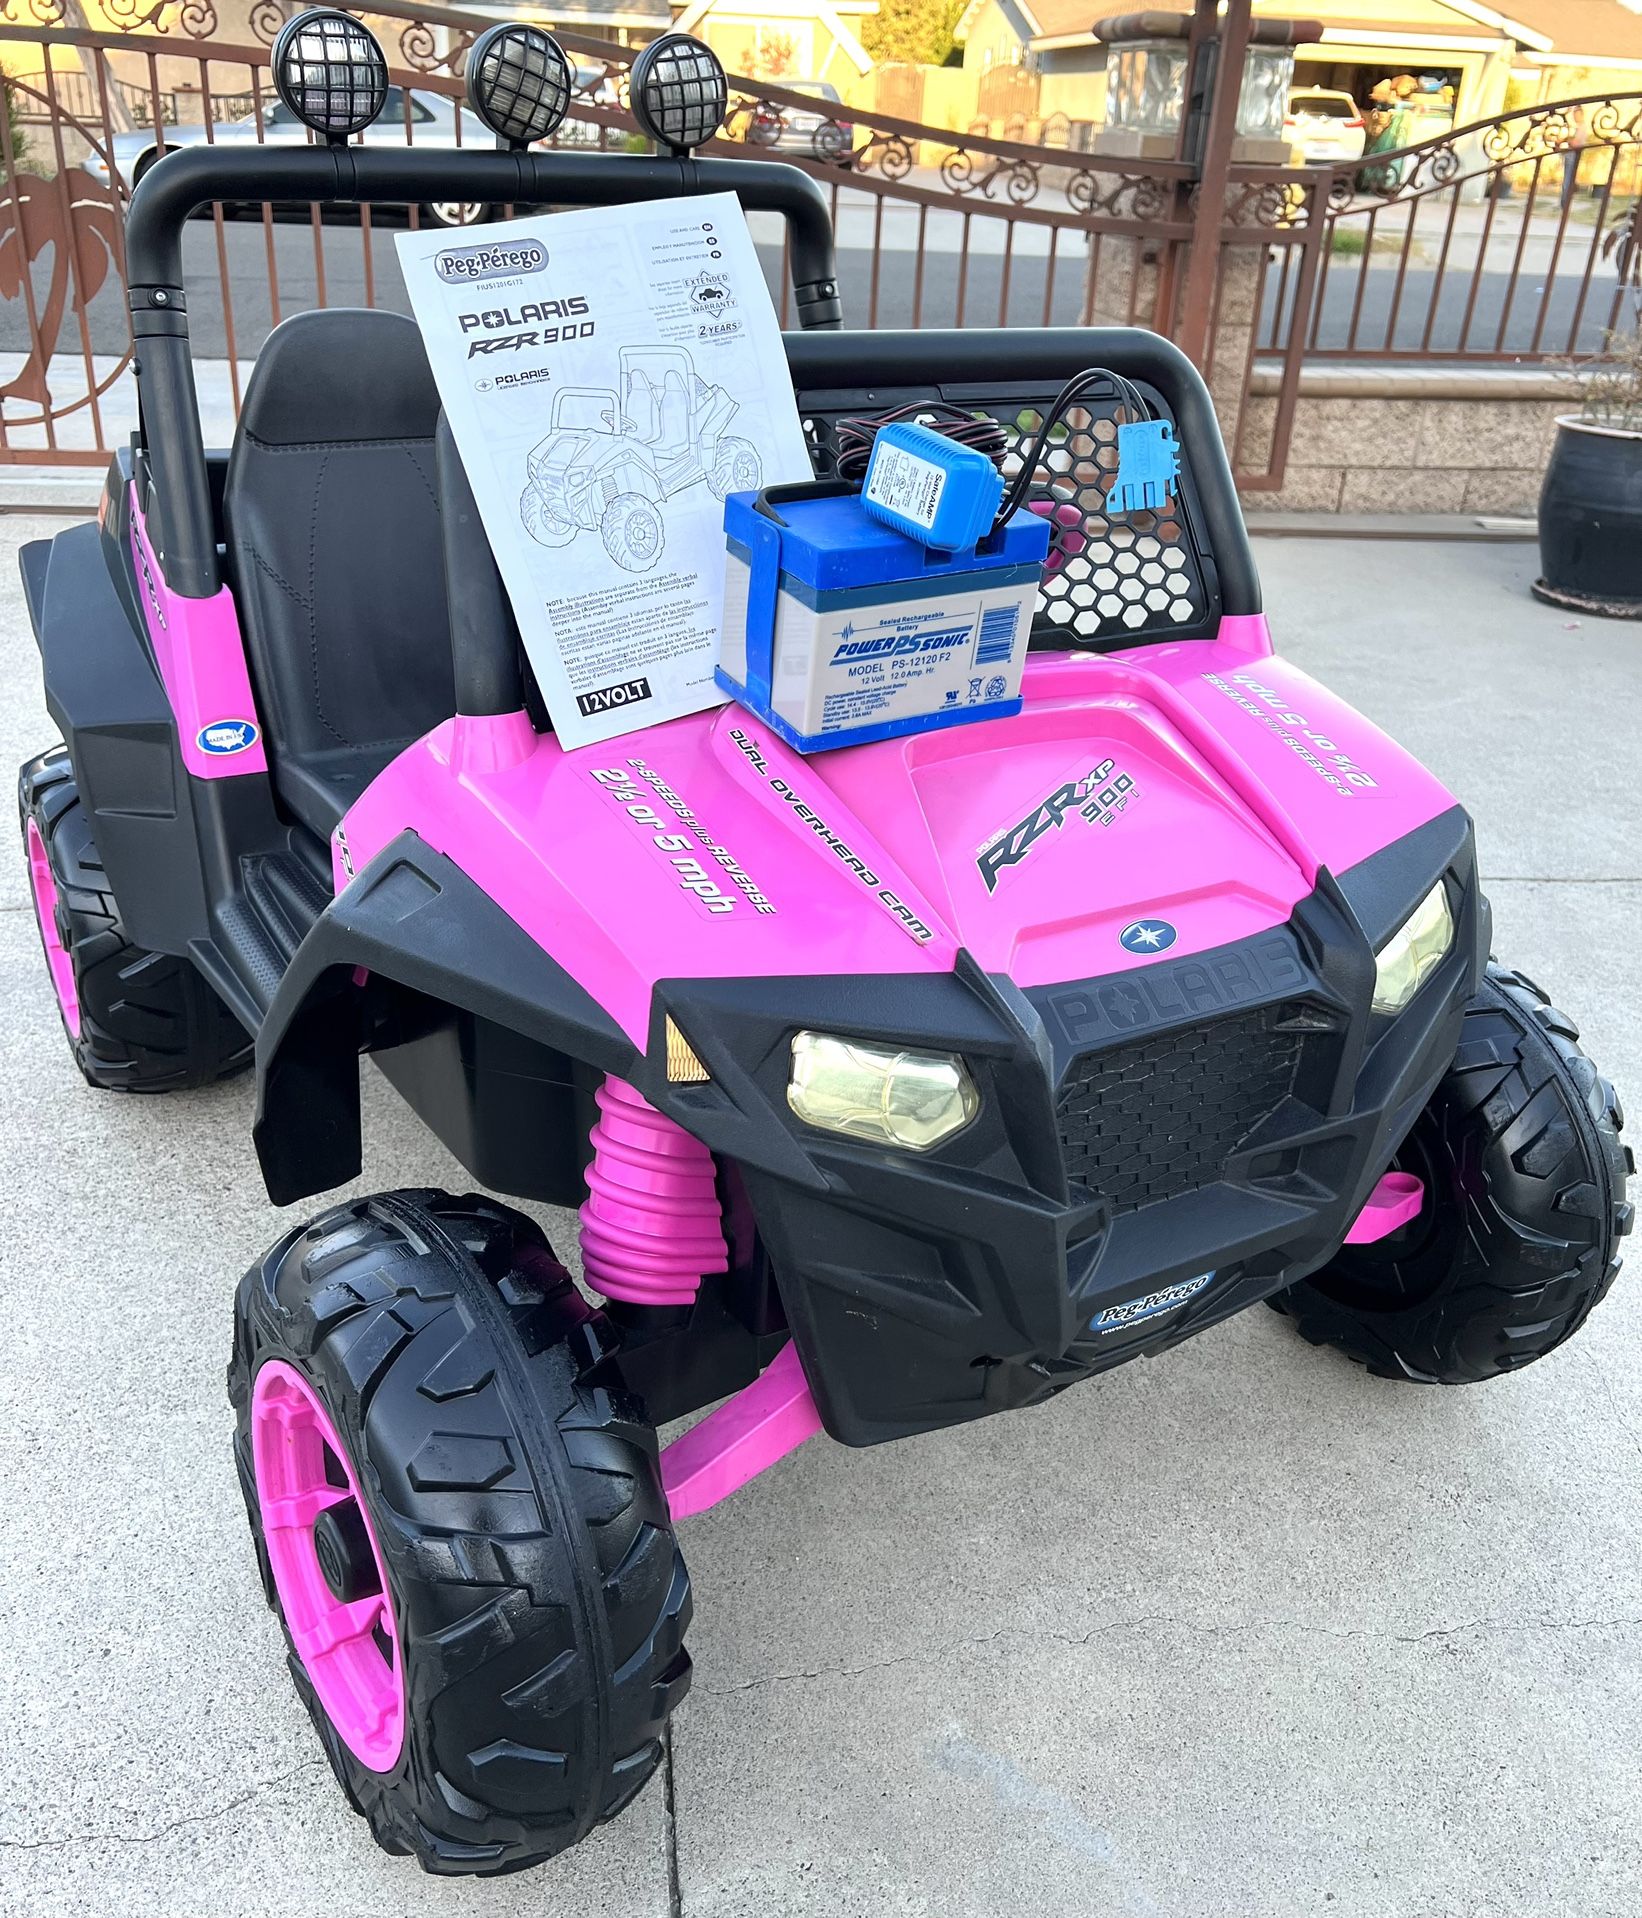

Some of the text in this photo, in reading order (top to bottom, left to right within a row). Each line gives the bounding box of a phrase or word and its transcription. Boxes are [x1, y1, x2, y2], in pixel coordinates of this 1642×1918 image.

[684, 274, 728, 287] EXTENDED
[458, 296, 590, 333] POLARIS
[691, 300, 736, 313] WARRANTY
[467, 321, 596, 360] RZR 900
[699, 325, 707, 335] 2
[494, 369, 550, 385] POLARIS
[599, 586, 617, 594] manual
[618, 582, 638, 590] contains
[614, 590, 635, 598] separate
[682, 573, 698, 582] verbal
[550, 608, 580, 620] instructions
[609, 597, 624, 605] verbal
[625, 592, 653, 601] instructions
[663, 583, 680, 592] several
[679, 579, 694, 589] pages
[551, 616, 570, 626] deeper
[570, 614, 582, 622] into
[587, 620, 606, 628] manual
[879, 611, 945, 627] Sealed Rechargeable
[896, 623, 919, 633] Battery
[680, 635, 708, 647] instructions
[834, 639, 893, 658] POWER
[919, 632, 969, 650] SONIC
[848, 652, 951, 677] MODEL PS-12120 F2
[861, 677, 870, 685] 12
[871, 674, 885, 683] Volt
[891, 672, 906, 680] 12.0
[1232, 673, 1282, 708] mph
[582, 680, 646, 713] 12VOLT
[1200, 671, 1268, 717] REVERSE
[1262, 716, 1290, 738] plus
[1277, 711, 1308, 727] 5
[1303, 727, 1337, 751] or
[1080, 772, 1136, 825] 900
[625, 804, 664, 831] or
[653, 833, 694, 852] 5
[729, 729, 769, 777] DUAL
[770, 778, 882, 889] OVERHEAD
[876, 889, 935, 941] CAM
[976, 780, 1083, 897] RZR
[688, 817, 715, 846] plus
[706, 845, 777, 915] REVERSE
[669, 856, 734, 914] mph
[1047, 936, 1309, 1046] POLARIS
